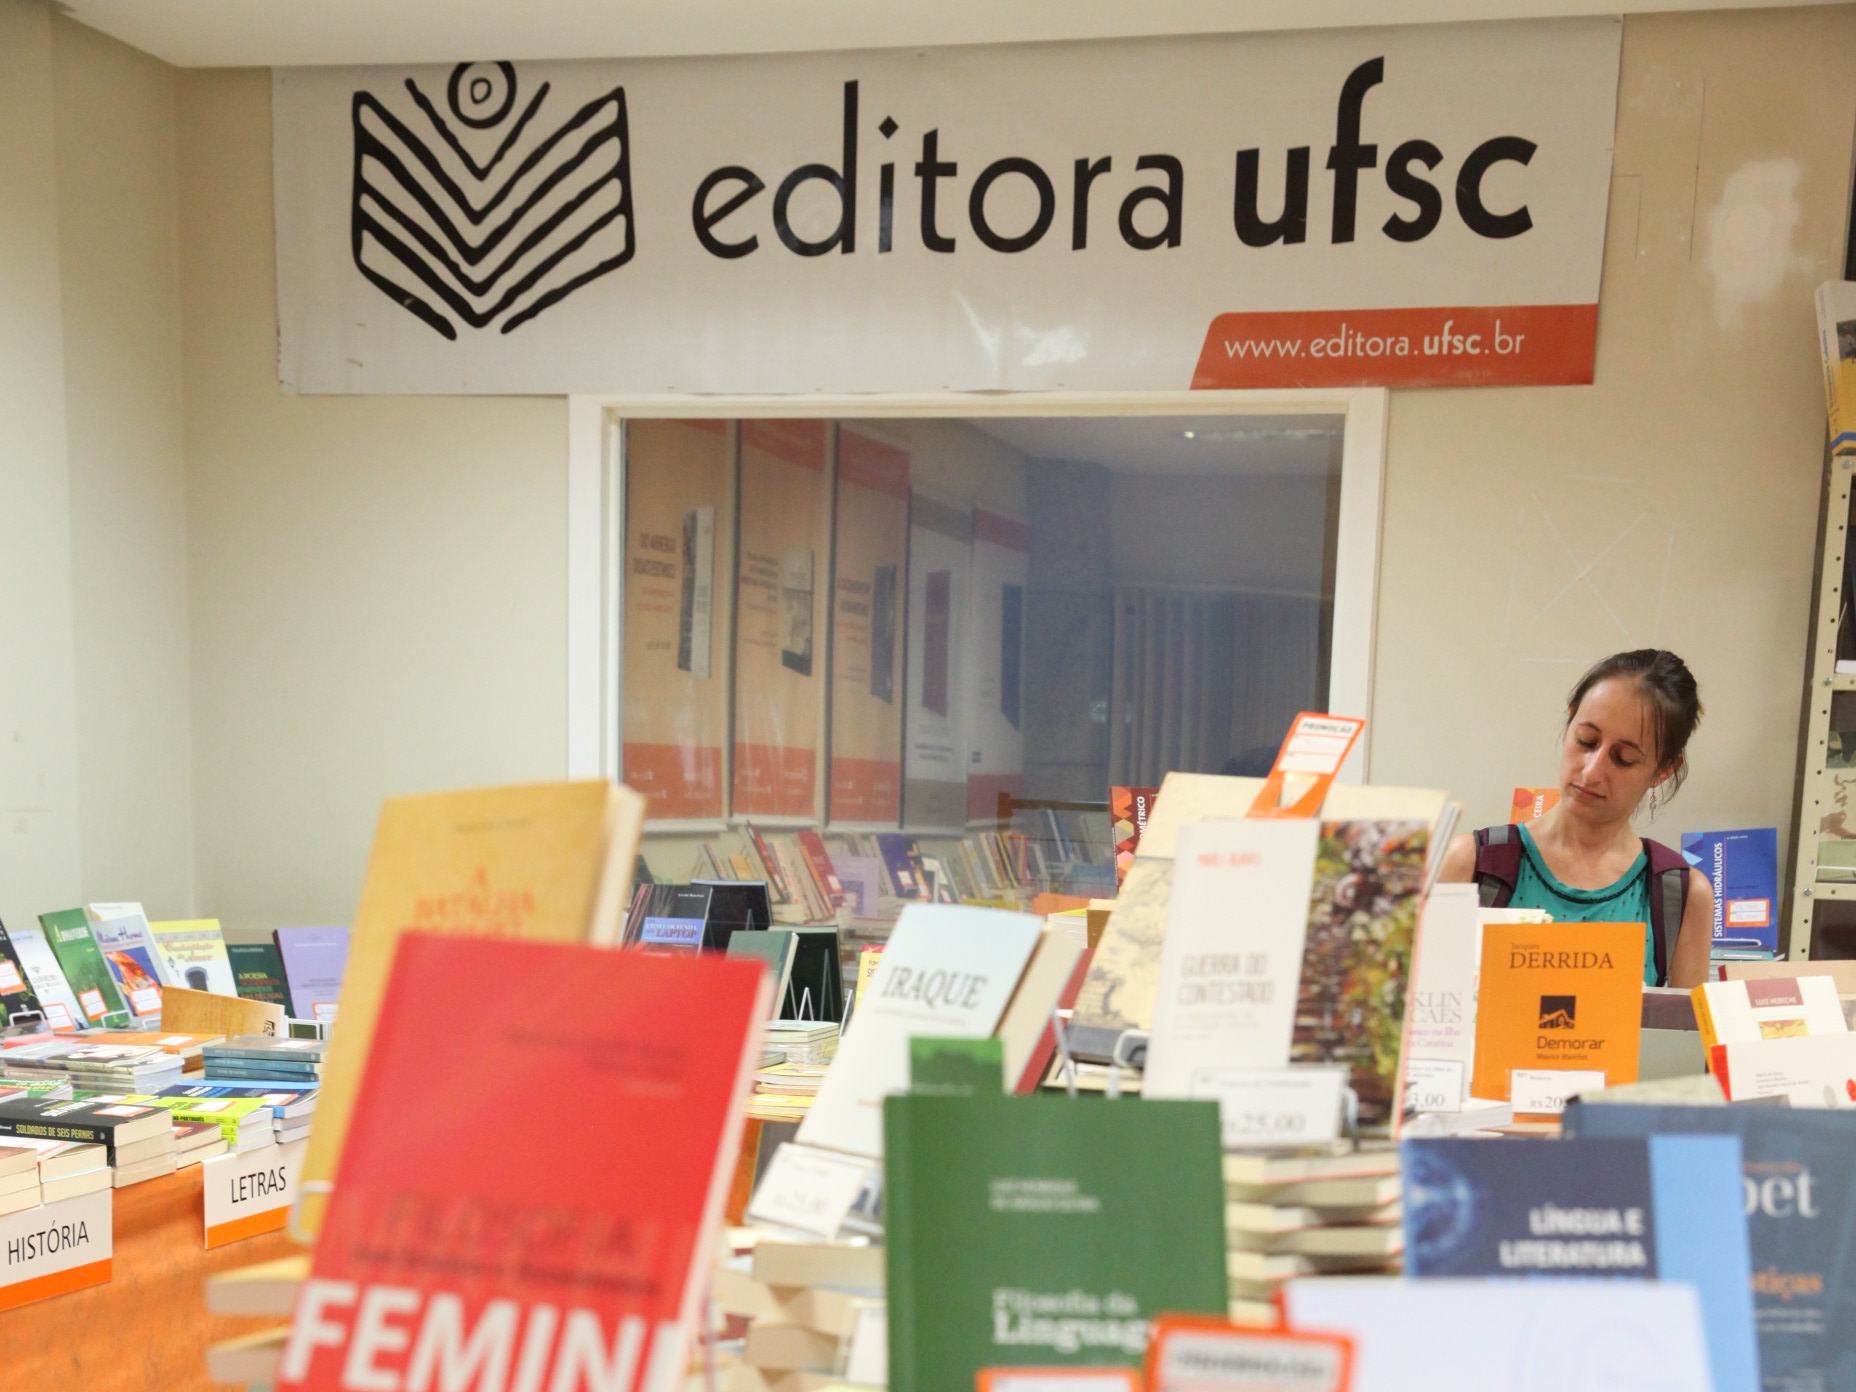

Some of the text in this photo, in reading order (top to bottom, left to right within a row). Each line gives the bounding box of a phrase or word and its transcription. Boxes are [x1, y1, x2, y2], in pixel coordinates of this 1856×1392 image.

[692, 56, 1538, 259] editora ufsc
[1224, 319, 1525, 359] www.editora.ufsc.br
[1712, 842, 1723, 937] SISTEMAS HIDRÁULICOS
[656, 929, 697, 939] LAPTOP
[1181, 953, 1240, 978] GUERRA
[1509, 951, 1615, 969] DERRIDA
[881, 964, 989, 1010] IRAQUE
[1177, 981, 1274, 1005] CONTESTADO
[1537, 1036, 1605, 1050] Demorar
[16, 1124, 47, 1136] SOLDADOS
[48, 1127, 56, 1137] DE
[57, 1128, 70, 1138] SEIS
[71, 1129, 94, 1140] PERNAS
[231, 1166, 287, 1204] LETRAS
[1529, 1200, 1645, 1236] LÍNGUA E
[8, 1219, 90, 1266] HISTÓRIA
[1499, 1240, 1648, 1268] LITERATURA
[993, 1287, 1100, 1315] Filosofia
